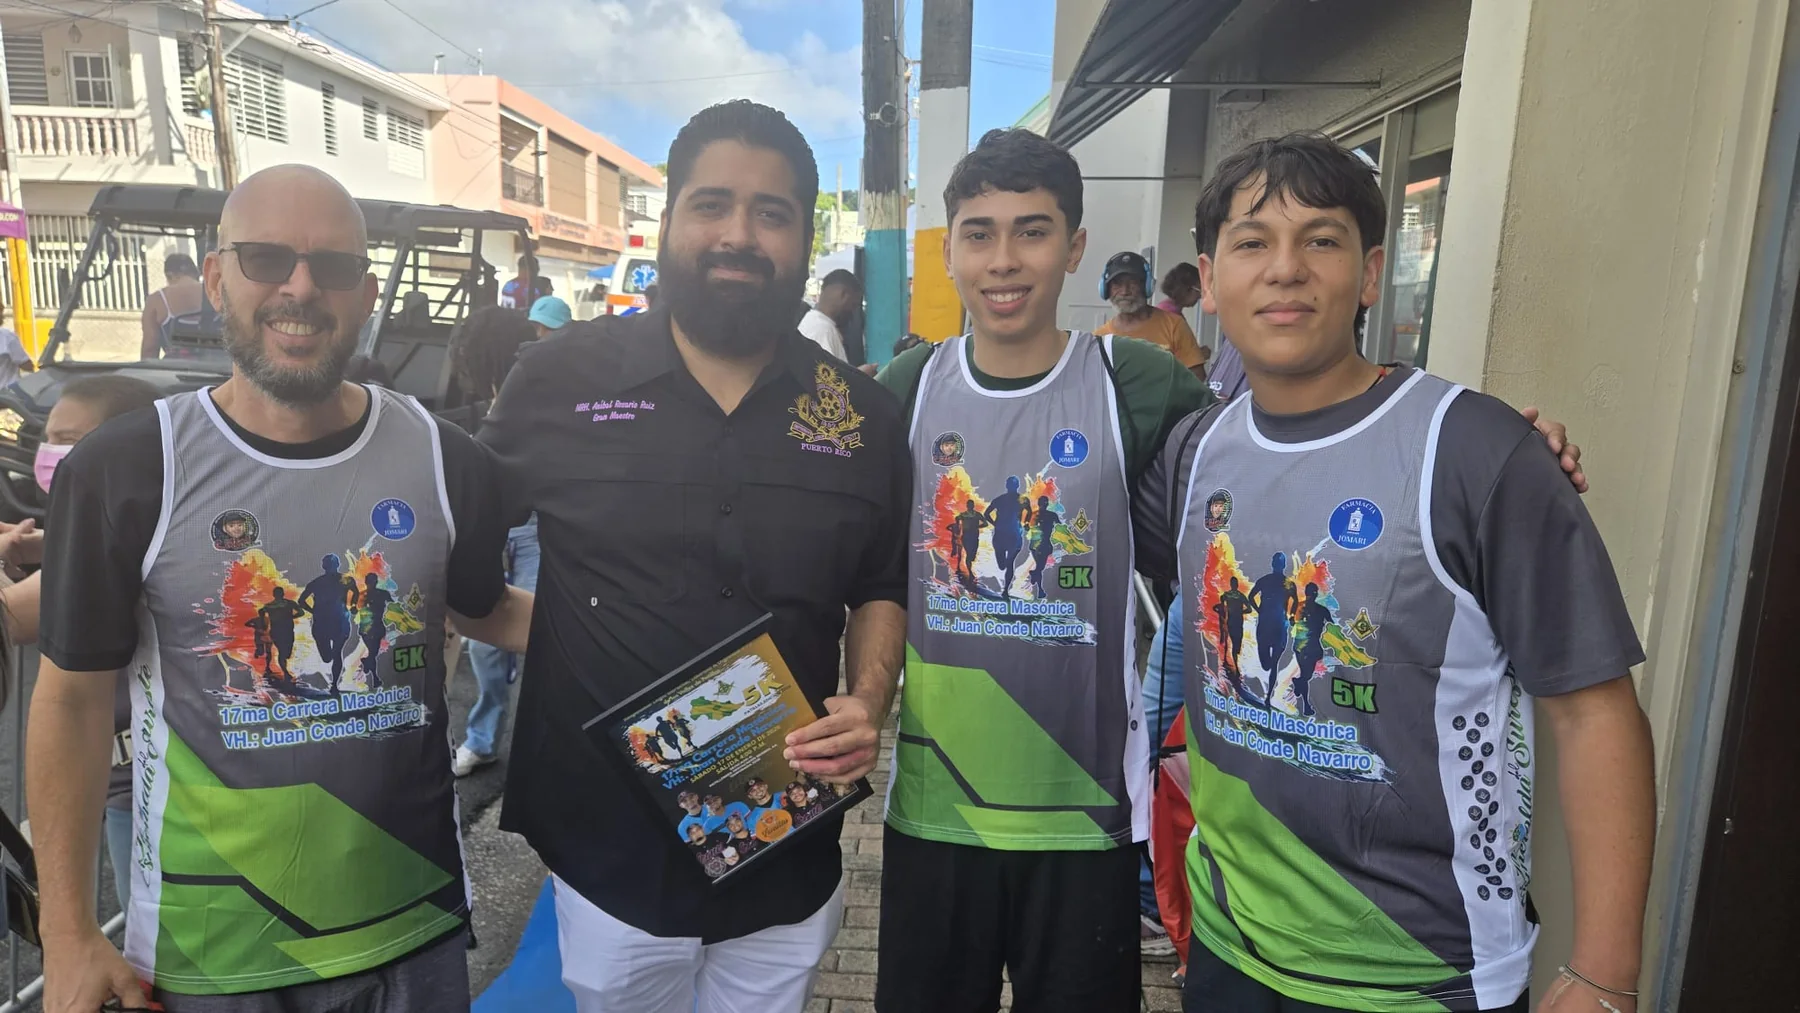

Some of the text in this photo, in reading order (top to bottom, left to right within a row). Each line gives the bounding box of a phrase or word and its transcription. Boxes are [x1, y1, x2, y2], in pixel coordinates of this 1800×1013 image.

[801, 443, 852, 458] PUERTO RICO
[1340, 500, 1377, 515] FARMACIA
[1338, 534, 1367, 545] JOMARI
[1058, 566, 1093, 588] 5K
[928, 595, 1075, 615] 17ma Carrera Masónica
[926, 615, 1084, 637] VH.: Juan Conde Navarro
[393, 644, 426, 672] 5K
[742, 673, 783, 705] 5K
[1331, 677, 1378, 713] 5K
[221, 685, 412, 724] 17ma Carrera Masónica
[222, 707, 421, 749] VH.: Juan Conde Navarro
[1228, 696, 1268, 728] Carrera
[1271, 709, 1357, 742] Masónica
[691, 731, 736, 763] Carrera
[715, 732, 751, 759] Conde
[1247, 730, 1295, 759] Conde
[1298, 742, 1372, 771] Navarro
[715, 756, 740, 775] SALIDA
